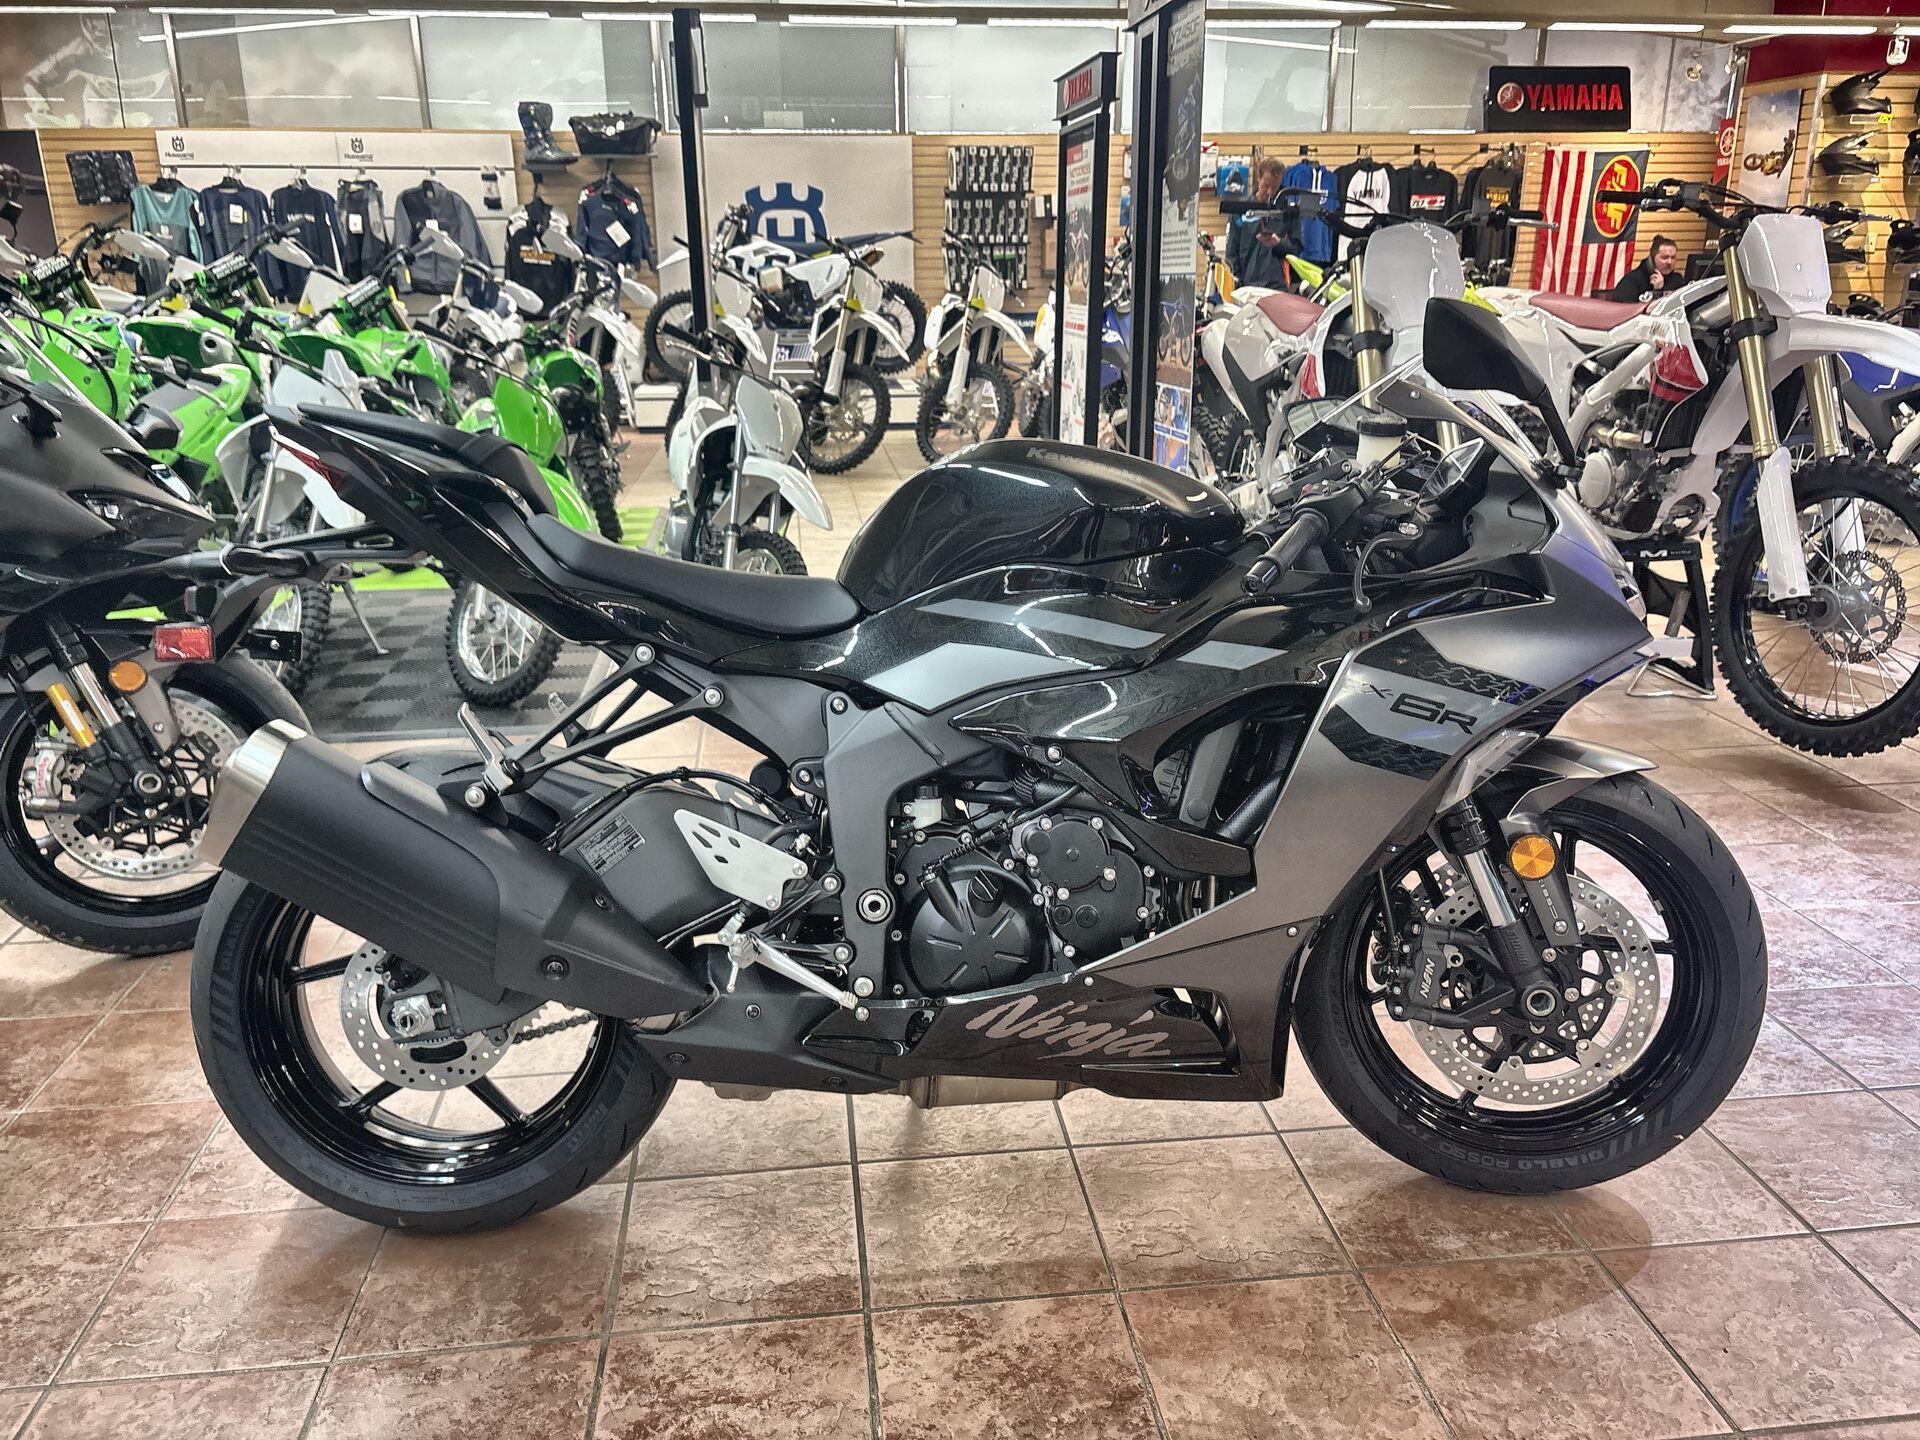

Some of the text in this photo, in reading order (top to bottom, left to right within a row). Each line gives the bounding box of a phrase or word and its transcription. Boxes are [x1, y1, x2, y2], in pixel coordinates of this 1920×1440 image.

[1068, 68, 1092, 105] YAMAHA
[1526, 83, 1623, 112] YAMAHA
[1420, 957, 1436, 999] NISSIN
[965, 994, 1172, 1060] Ninja
[1438, 1141, 1510, 1170] ROSSO
[1517, 1149, 1609, 1170] DIABLO
